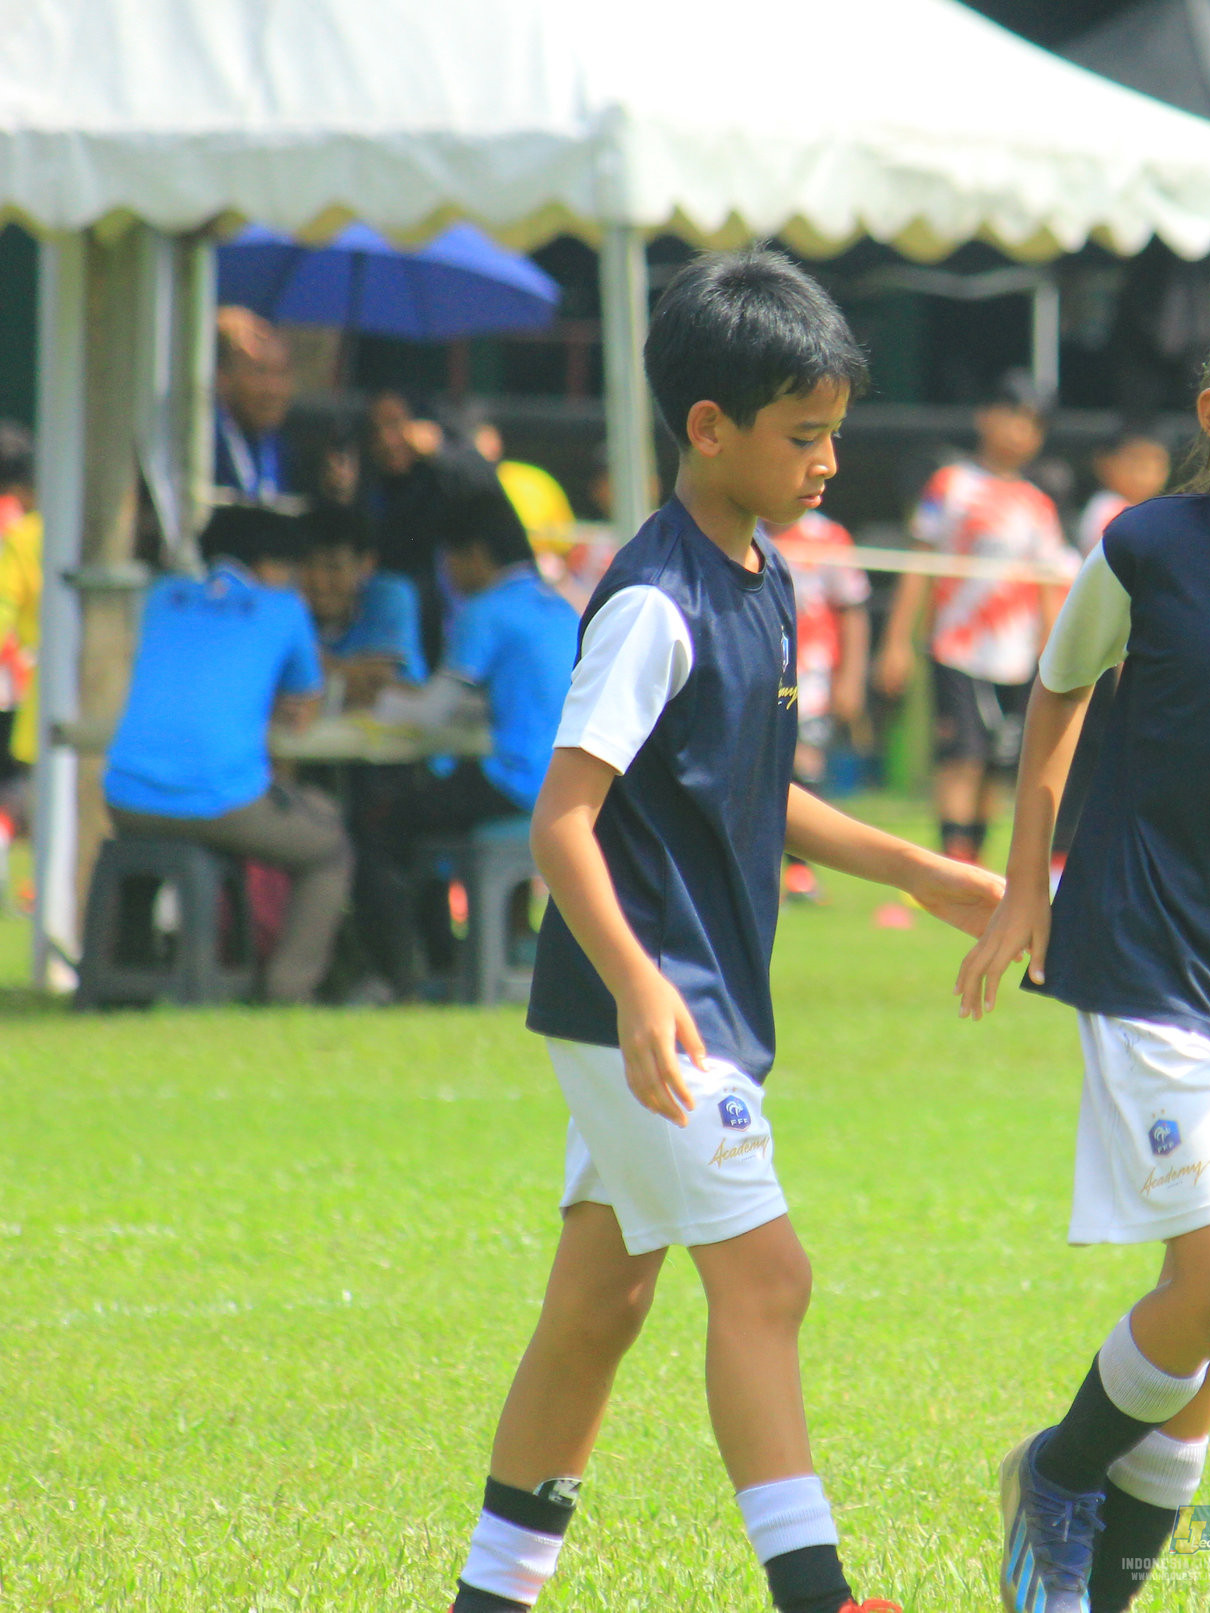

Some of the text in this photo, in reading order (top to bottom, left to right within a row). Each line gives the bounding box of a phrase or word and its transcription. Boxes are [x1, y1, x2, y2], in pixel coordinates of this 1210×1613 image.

[730, 1118, 748, 1126] FFF
[707, 1136, 770, 1169] Academy
[1138, 1160, 1210, 1197] Academy
